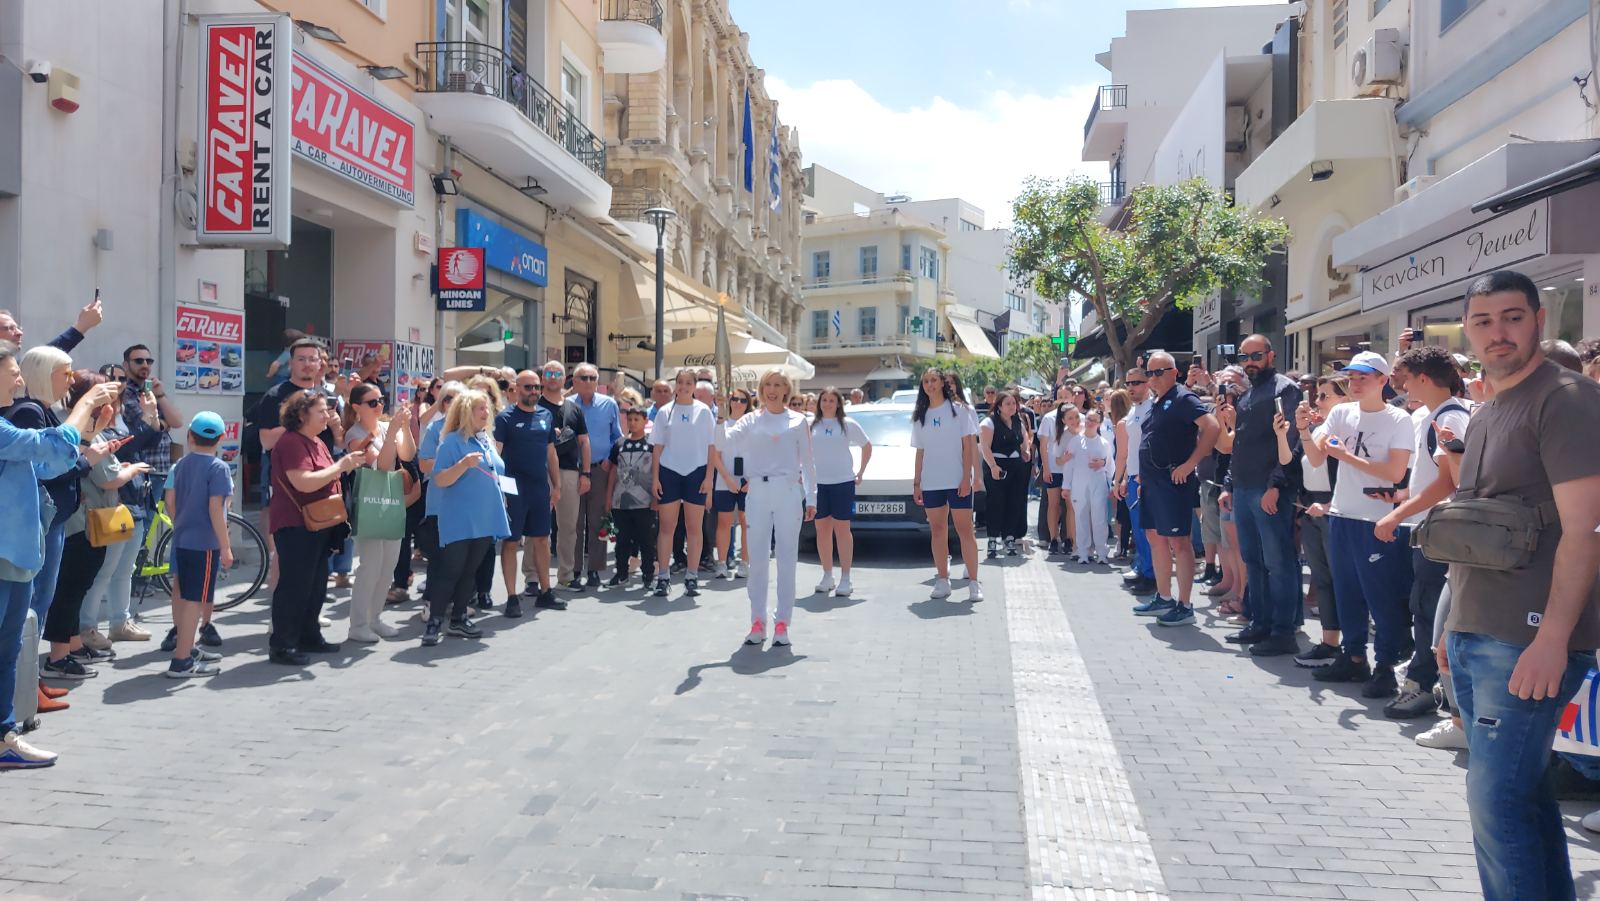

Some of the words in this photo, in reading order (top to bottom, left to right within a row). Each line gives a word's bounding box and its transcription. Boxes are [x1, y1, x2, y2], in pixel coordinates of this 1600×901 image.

[255, 29, 272, 96] CAR
[209, 33, 252, 224] CARAVEL
[254, 107, 271, 129] A
[253, 140, 270, 227] RENT
[295, 140, 303, 151] A
[308, 146, 328, 164] CAR
[340, 162, 413, 203] AUTOVERMIETUNG
[1466, 208, 1539, 273] Jewel
[440, 290, 482, 299] MINOAN
[446, 299, 474, 309] LINES
[177, 311, 240, 340] CARAVEL
[396, 343, 413, 371] RENT
[415, 345, 420, 371] A
[421, 347, 433, 373] CAR
